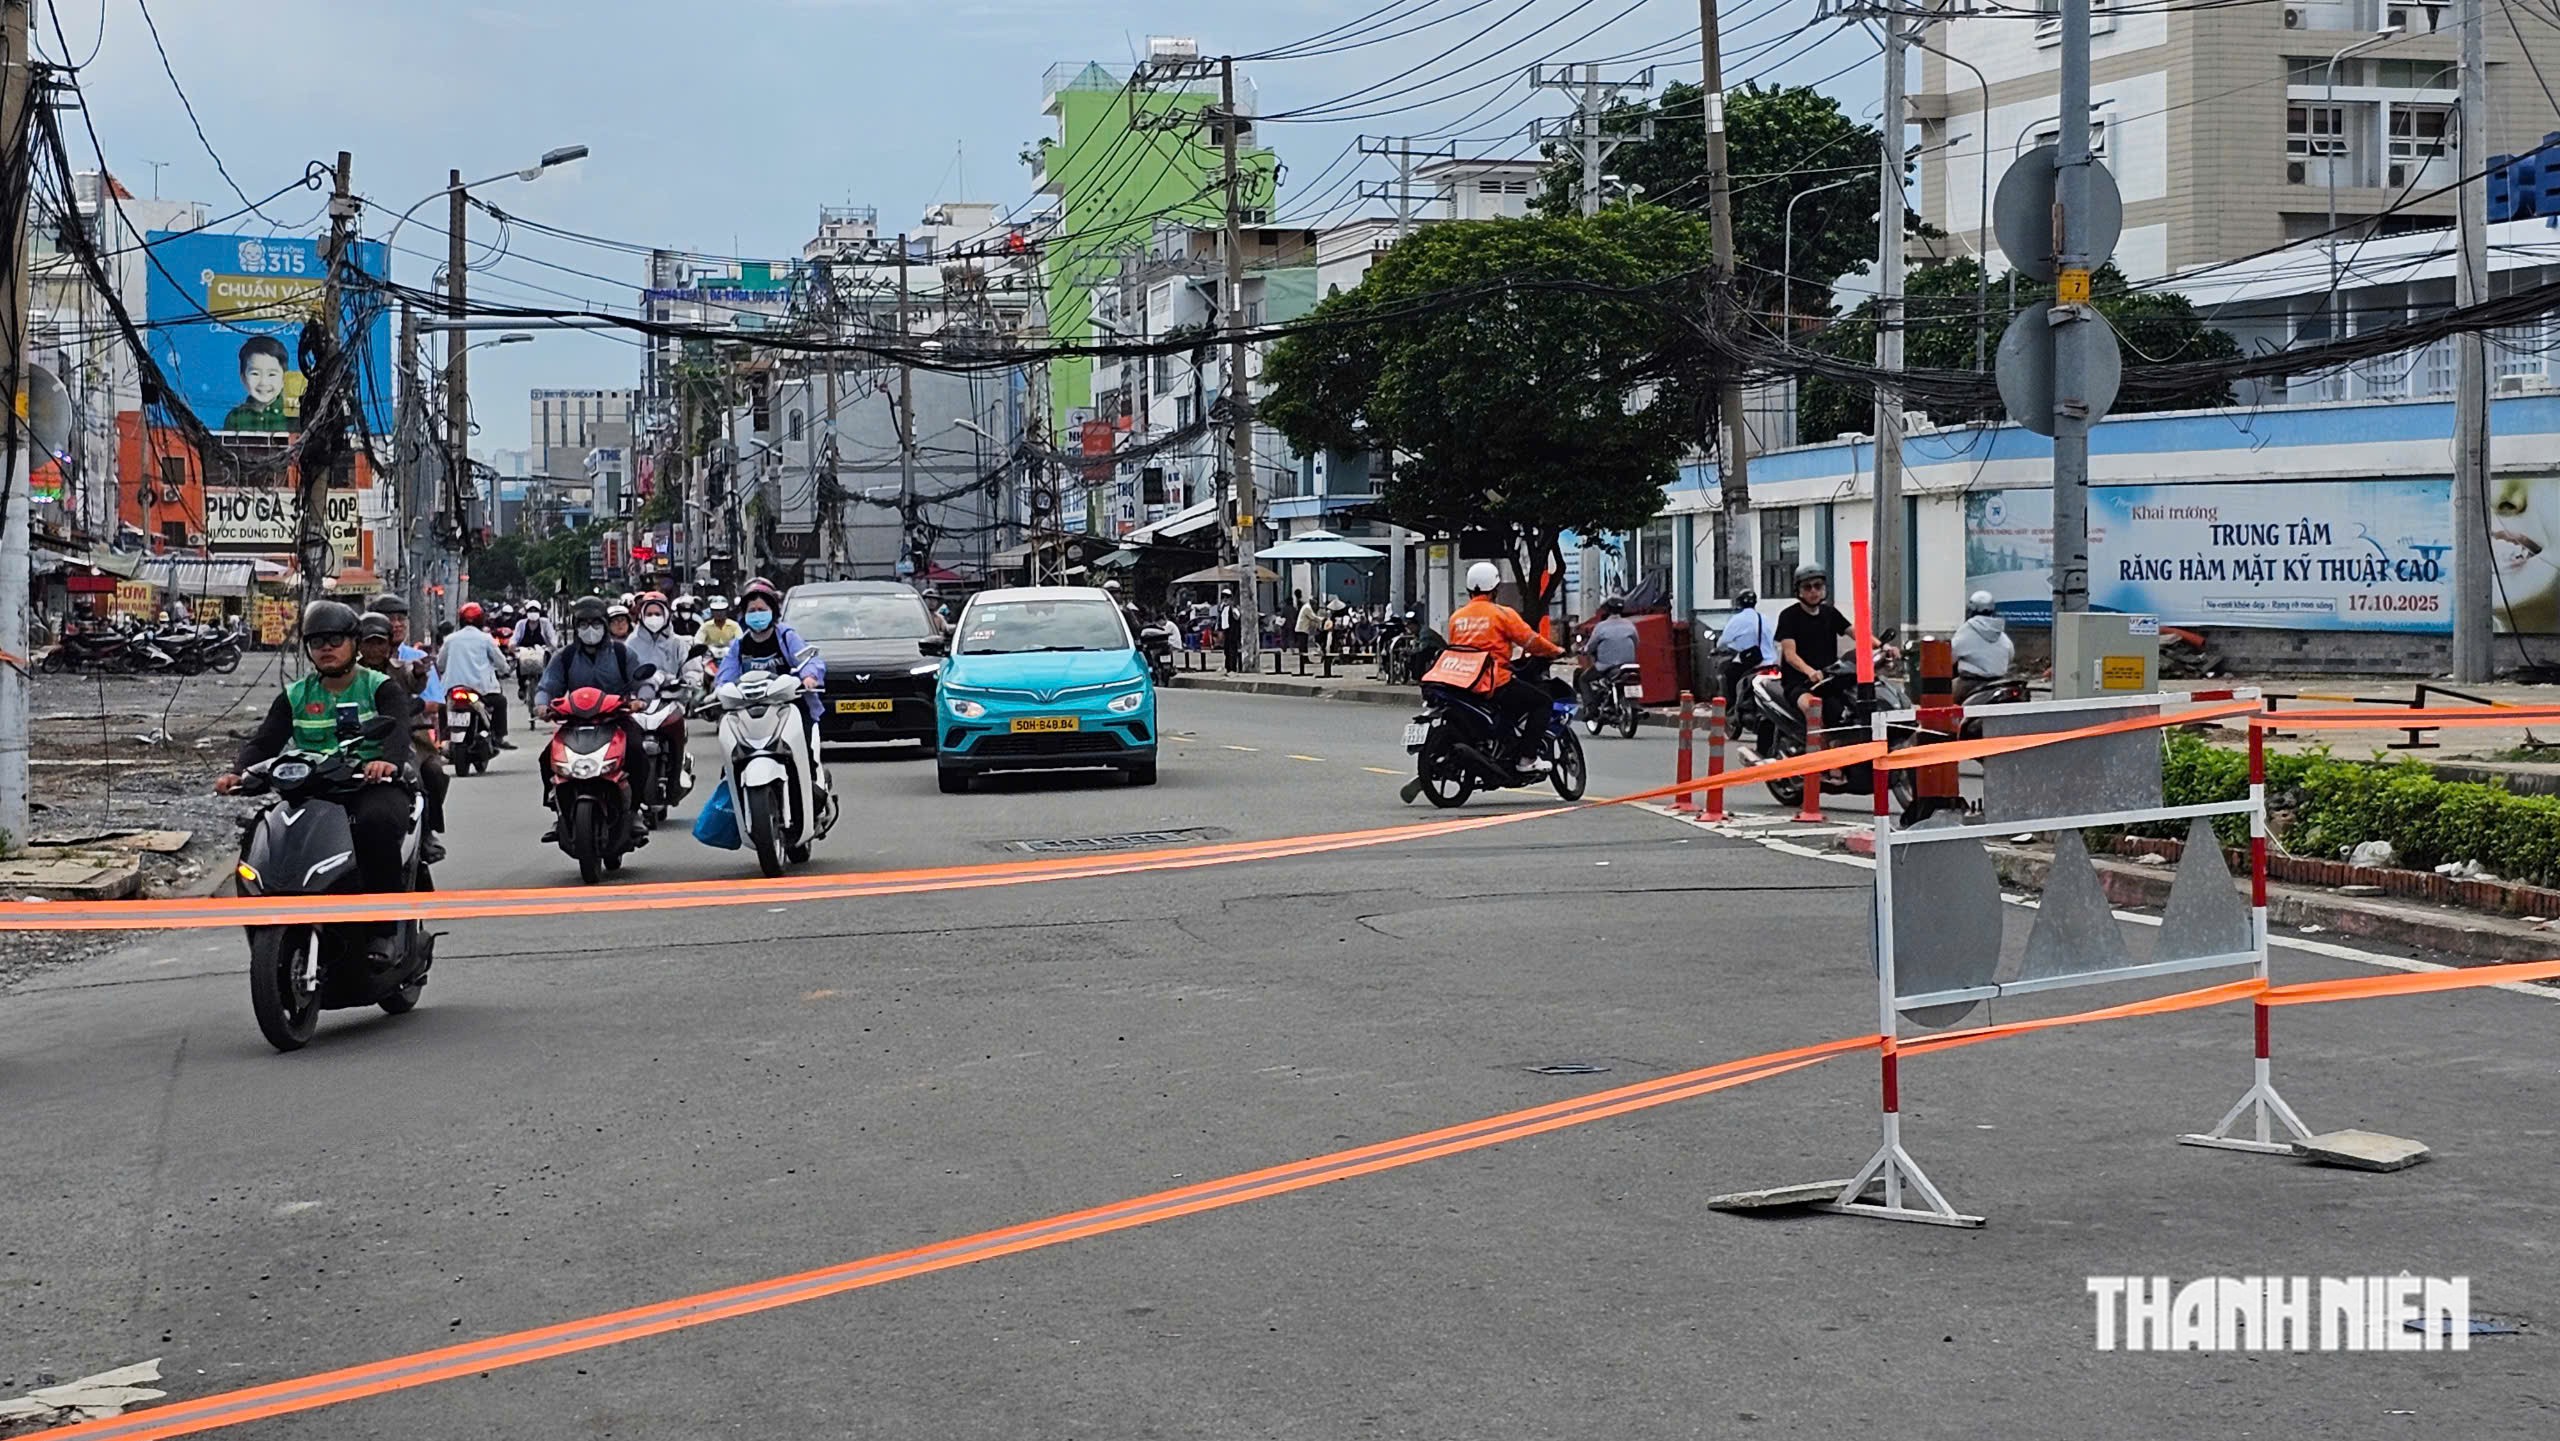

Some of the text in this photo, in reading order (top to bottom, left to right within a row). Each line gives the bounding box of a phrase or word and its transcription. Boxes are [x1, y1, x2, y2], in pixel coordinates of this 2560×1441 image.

[269, 254, 305, 273] 315
[2075, 282, 2080, 293] 7
[1121, 462, 1135, 475] NH
[1122, 502, 1135, 519] TÂ
[2132, 505, 2218, 522] Khai trương
[2209, 517, 2331, 546] TRUNG TÂM
[344, 544, 356, 552] AY
[2119, 552, 2439, 588] RĂNG HÀM MẶT KỸ THUẬT CAO
[2349, 595, 2439, 611] 17.10.2025
